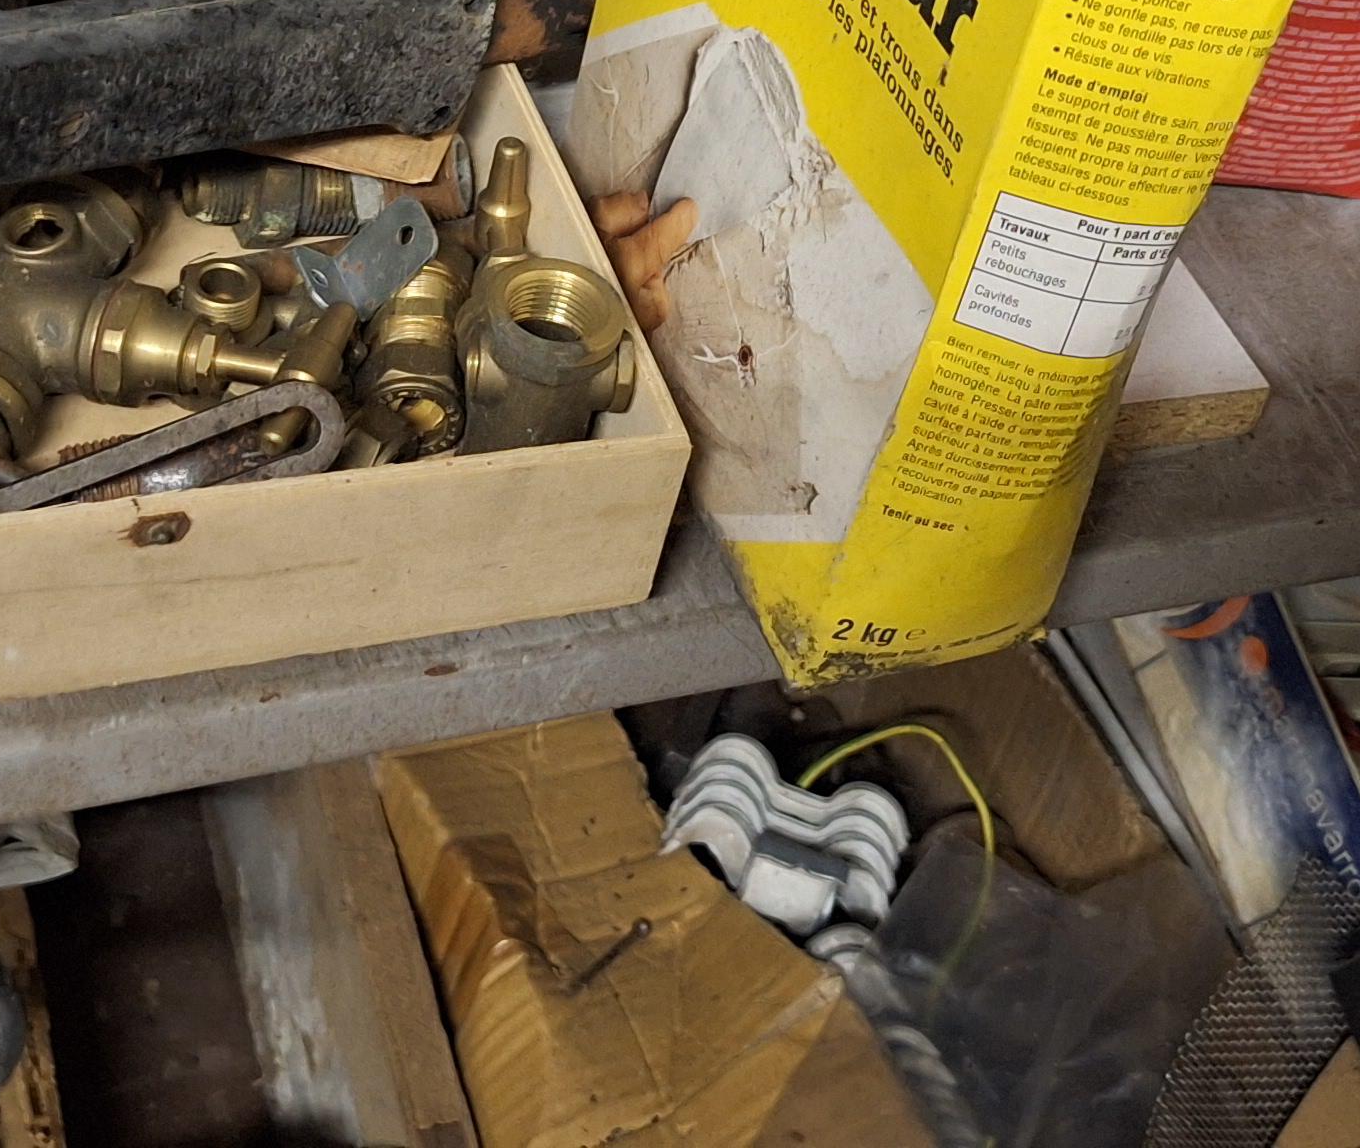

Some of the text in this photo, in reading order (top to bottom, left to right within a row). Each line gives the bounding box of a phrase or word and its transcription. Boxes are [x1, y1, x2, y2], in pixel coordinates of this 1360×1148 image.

[1075, 12, 1096, 29] Ne
[1098, 20, 1115, 34] se
[1117, 23, 1168, 46] fendille
[1168, 37, 1196, 51] pas
[1197, 39, 1224, 55] lors
[1226, 43, 1244, 57] de
[1103, 3, 1148, 23] gonfle
[1182, 20, 1201, 33] ne
[1202, 24, 1249, 40] creuse
[1070, 31, 1108, 51] clous
[1110, 42, 1130, 56] ou
[1132, 45, 1150, 60] de
[1063, 45, 1114, 70] Résiste
[1115, 62, 1143, 77] aux
[879, 20, 922, 92] trous
[923, 87, 964, 154] dans
[1043, 66, 1149, 105] Mode d'emploi
[853, 29, 955, 189] plafonnages.
[1031, 102, 1082, 125] exempt
[1083, 115, 1101, 129] de
[1037, 84, 1055, 99] Le
[1057, 91, 1111, 115] support
[1112, 104, 1140, 121] doit
[1142, 109, 1169, 126] être
[1019, 134, 1078, 160] récipient
[1078, 151, 1125, 172] propre
[1126, 160, 1140, 174] la
[1140, 165, 1170, 178] part
[1085, 132, 1104, 149] Ne
[1105, 140, 1132, 155] pas
[1008, 164, 1057, 189] tableau
[1014, 151, 1091, 181] nécessaires
[1092, 173, 1127, 188] pour
[999, 216, 1052, 243] Travaux
[1076, 218, 1110, 237] Pour
[1113, 226, 1121, 239] 1
[1120, 229, 1151, 244] part
[990, 239, 1027, 261] Petits
[1112, 246, 1147, 260] Parts
[974, 284, 1020, 308] Cavités
[967, 299, 1033, 329] profondes
[946, 335, 974, 354] Bien
[923, 396, 960, 416] cavité
[961, 408, 970, 420] à
[1006, 390, 1022, 405] La
[917, 411, 964, 433] surface
[905, 437, 943, 457] Après
[901, 452, 944, 472] abrasif
[962, 484, 978, 496] de
[882, 504, 955, 532] Tenir au sec
[831, 618, 854, 640] 2
[860, 622, 898, 647] kg
